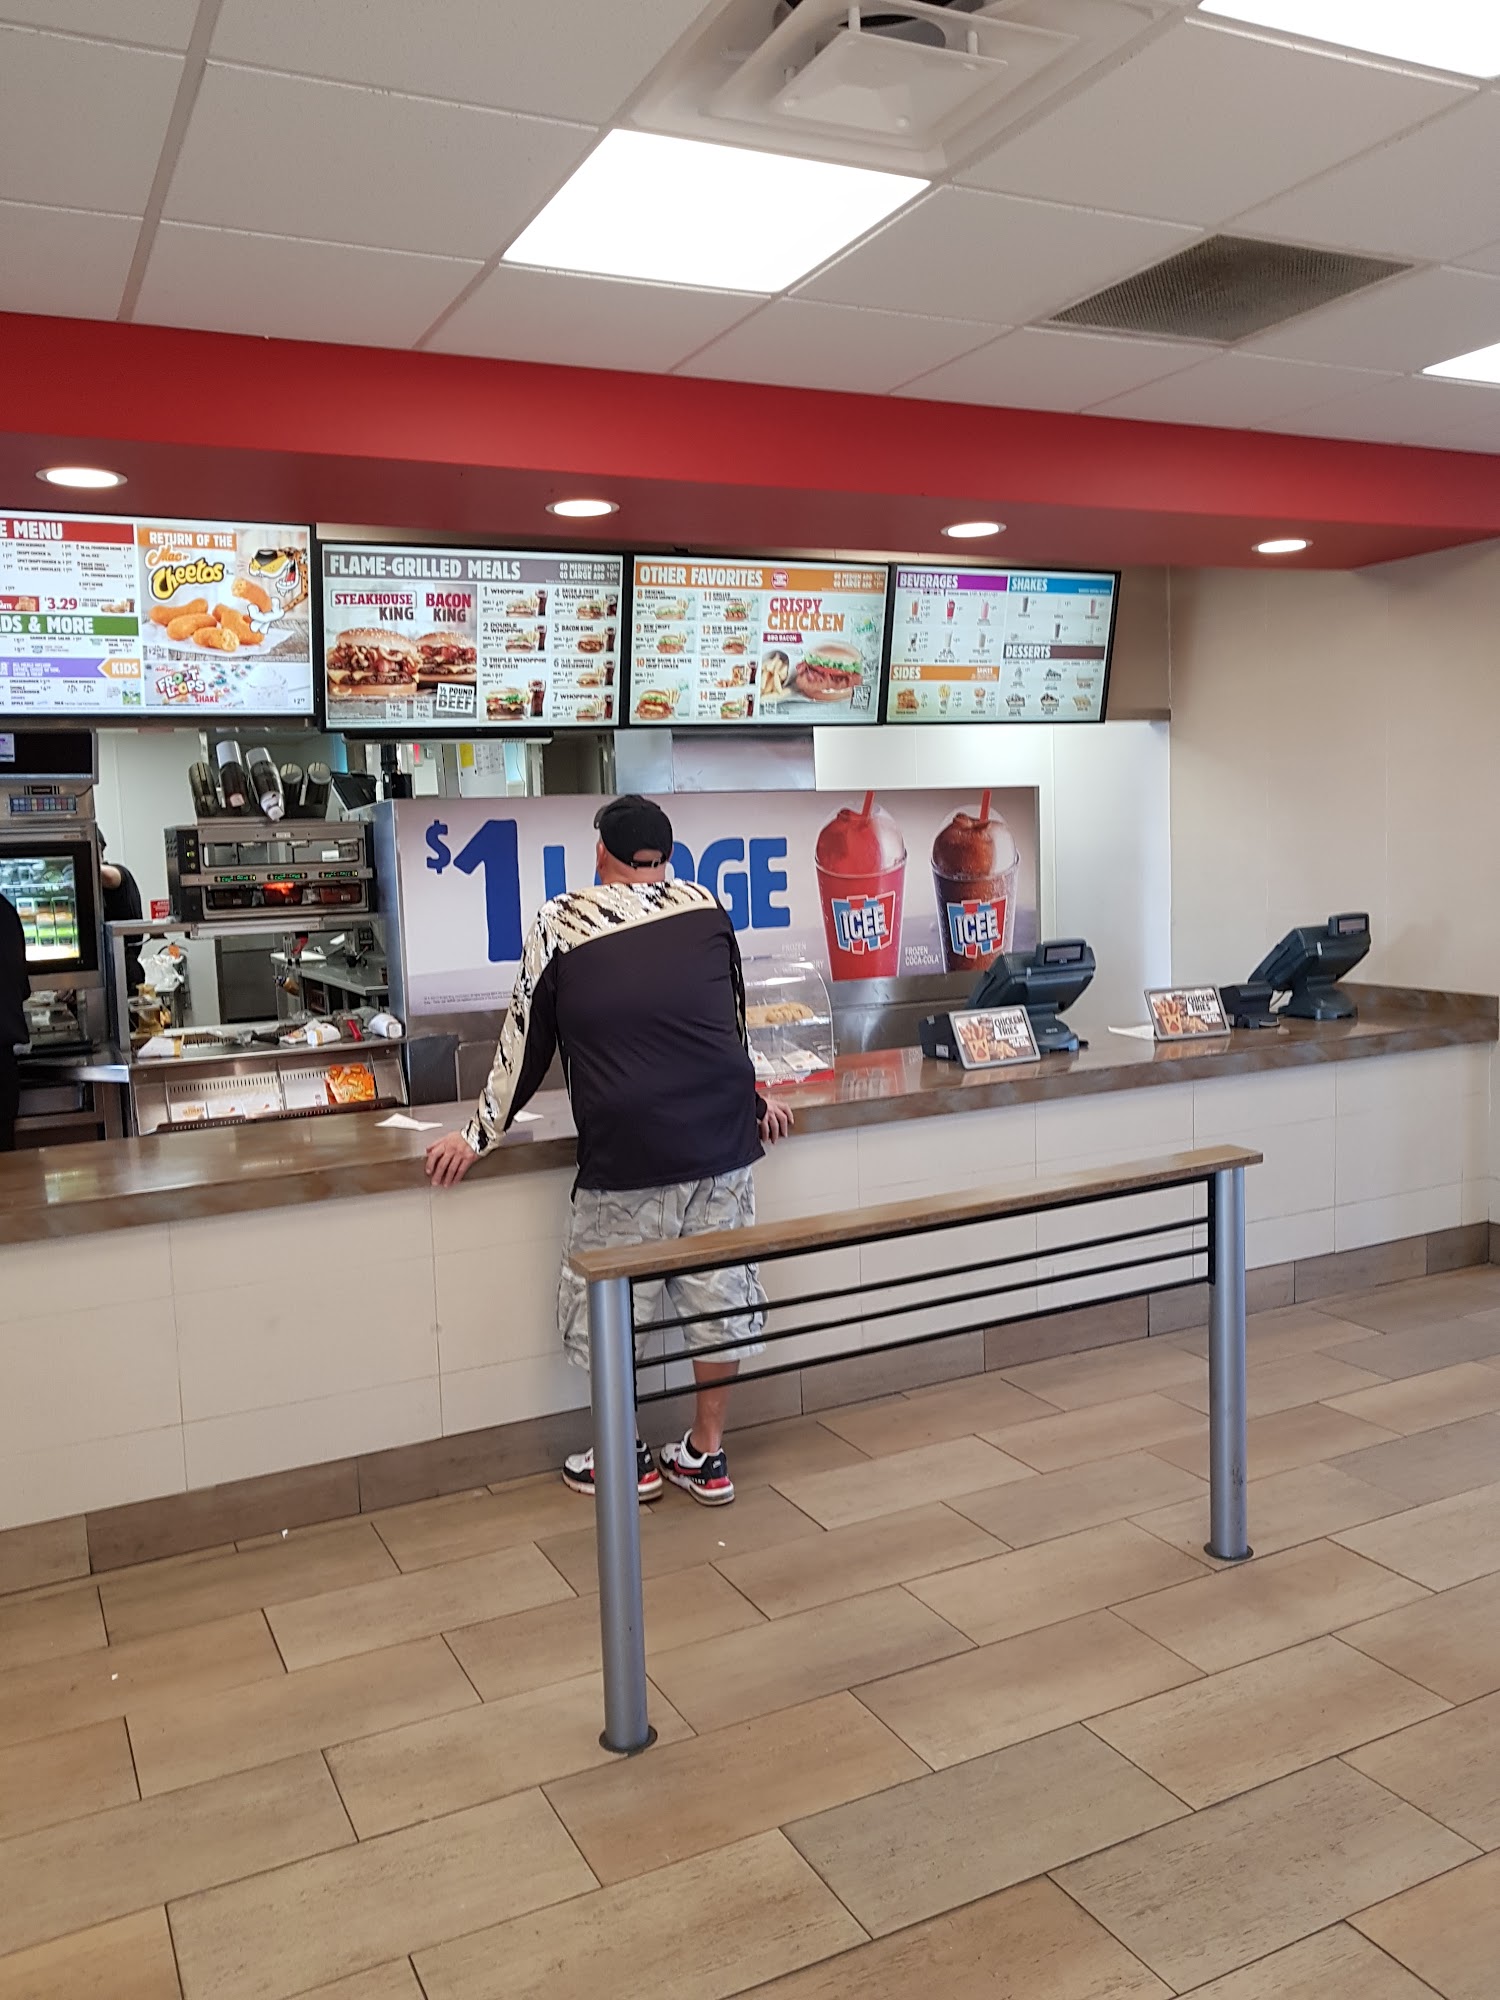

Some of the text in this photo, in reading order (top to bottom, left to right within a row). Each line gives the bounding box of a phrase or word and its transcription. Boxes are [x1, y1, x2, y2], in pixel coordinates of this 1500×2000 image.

[13, 520, 63, 540] MENU
[149, 531, 233, 547] RETURN OF THE
[147, 545, 183, 565] Mac
[330, 555, 521, 581] FLAME-GRILLED MEALS
[151, 557, 225, 600] Cheetos
[570, 571, 592, 580] LARGE
[639, 565, 687, 586] OTHER
[691, 565, 763, 587] FAVORITES
[899, 573, 959, 589] BEVERAGES
[483, 586, 488, 596] 1
[1011, 577, 1048, 592] SHAKES
[334, 592, 413, 606] STEAKHOUSE
[425, 592, 472, 608] BACON
[554, 589, 560, 598] 4
[704, 592, 712, 600] 11
[769, 596, 822, 614] CRISPY
[379, 607, 414, 621] KING
[433, 608, 466, 623] KING
[0, 614, 94, 634] DS & MORE
[483, 623, 488, 632] 2
[767, 612, 845, 632] CHICKEN
[702, 625, 710, 635] 12
[1005, 644, 1051, 659] DESSERTS
[111, 662, 139, 675] KIDS
[482, 658, 488, 668] 3
[636, 658, 645, 668] 10
[701, 658, 710, 668] 13
[893, 666, 921, 680] SIDES
[194, 692, 219, 703] SHAKE
[449, 686, 472, 696] POUND
[438, 695, 472, 710] BEEF
[425, 818, 523, 963] $1
[839, 905, 886, 941] ICEE
[954, 908, 999, 945] ICEE
[904, 946, 928, 956] FROZEN
[904, 954, 941, 966] COCA-COLA
[1187, 992, 1215, 1005] CHICKEN
[1191, 1003, 1211, 1012] FRIES
[994, 1015, 1024, 1028] CHICKEN
[998, 1024, 1019, 1037] FRIES
